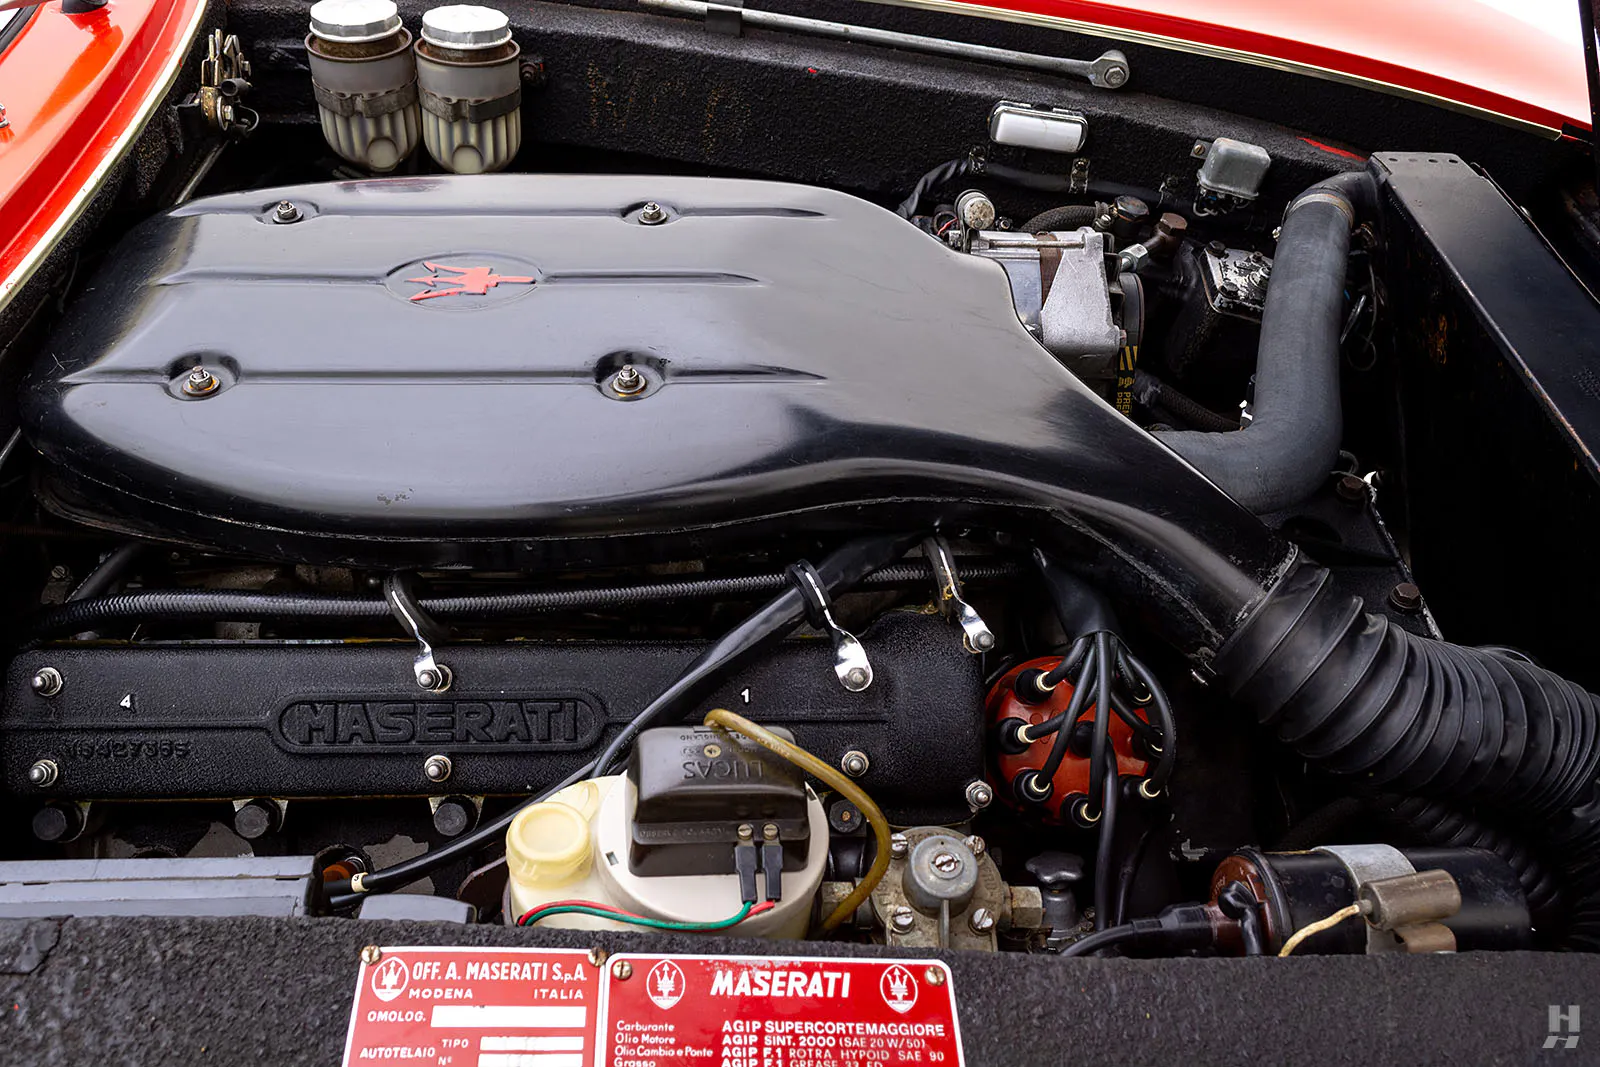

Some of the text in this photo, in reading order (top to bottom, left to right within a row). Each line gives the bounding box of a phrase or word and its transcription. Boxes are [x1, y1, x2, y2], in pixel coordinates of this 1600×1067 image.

[741, 688, 749, 703] 1
[299, 701, 580, 745] MASERATI
[682, 760, 764, 779] LUCAS
[412, 962, 442, 980] OFF.
[445, 962, 461, 980] A.
[465, 962, 548, 981] MASERATI
[710, 970, 851, 998] MASERATI
[408, 988, 473, 999] MODENA
[534, 989, 584, 999] ITALIA
[367, 1010, 426, 1022] OMOLOG.
[616, 1020, 675, 1031] Carburante
[722, 1020, 945, 1036] AGIP SUPERCORTEMAGGIORE
[442, 1039, 469, 1048] TIPO
[615, 1032, 676, 1044] Olio Motore
[722, 1034, 758, 1045] AGIP
[764, 1035, 796, 1046] SINT.
[798, 1036, 836, 1047] 2000
[839, 1037, 867, 1048] (SAE
[870, 1038, 884, 1048] 20
[360, 1047, 435, 1059] AUTOTELAIO
[614, 1045, 635, 1056] Olio
[636, 1045, 675, 1057] Cambio
[684, 1046, 713, 1057] Ponte
[721, 1046, 945, 1061] AGIP F.1 ROTRA HYPOID SAE 90
[614, 1057, 656, 1067] Grasso
[721, 1058, 758, 1067] AGIP
